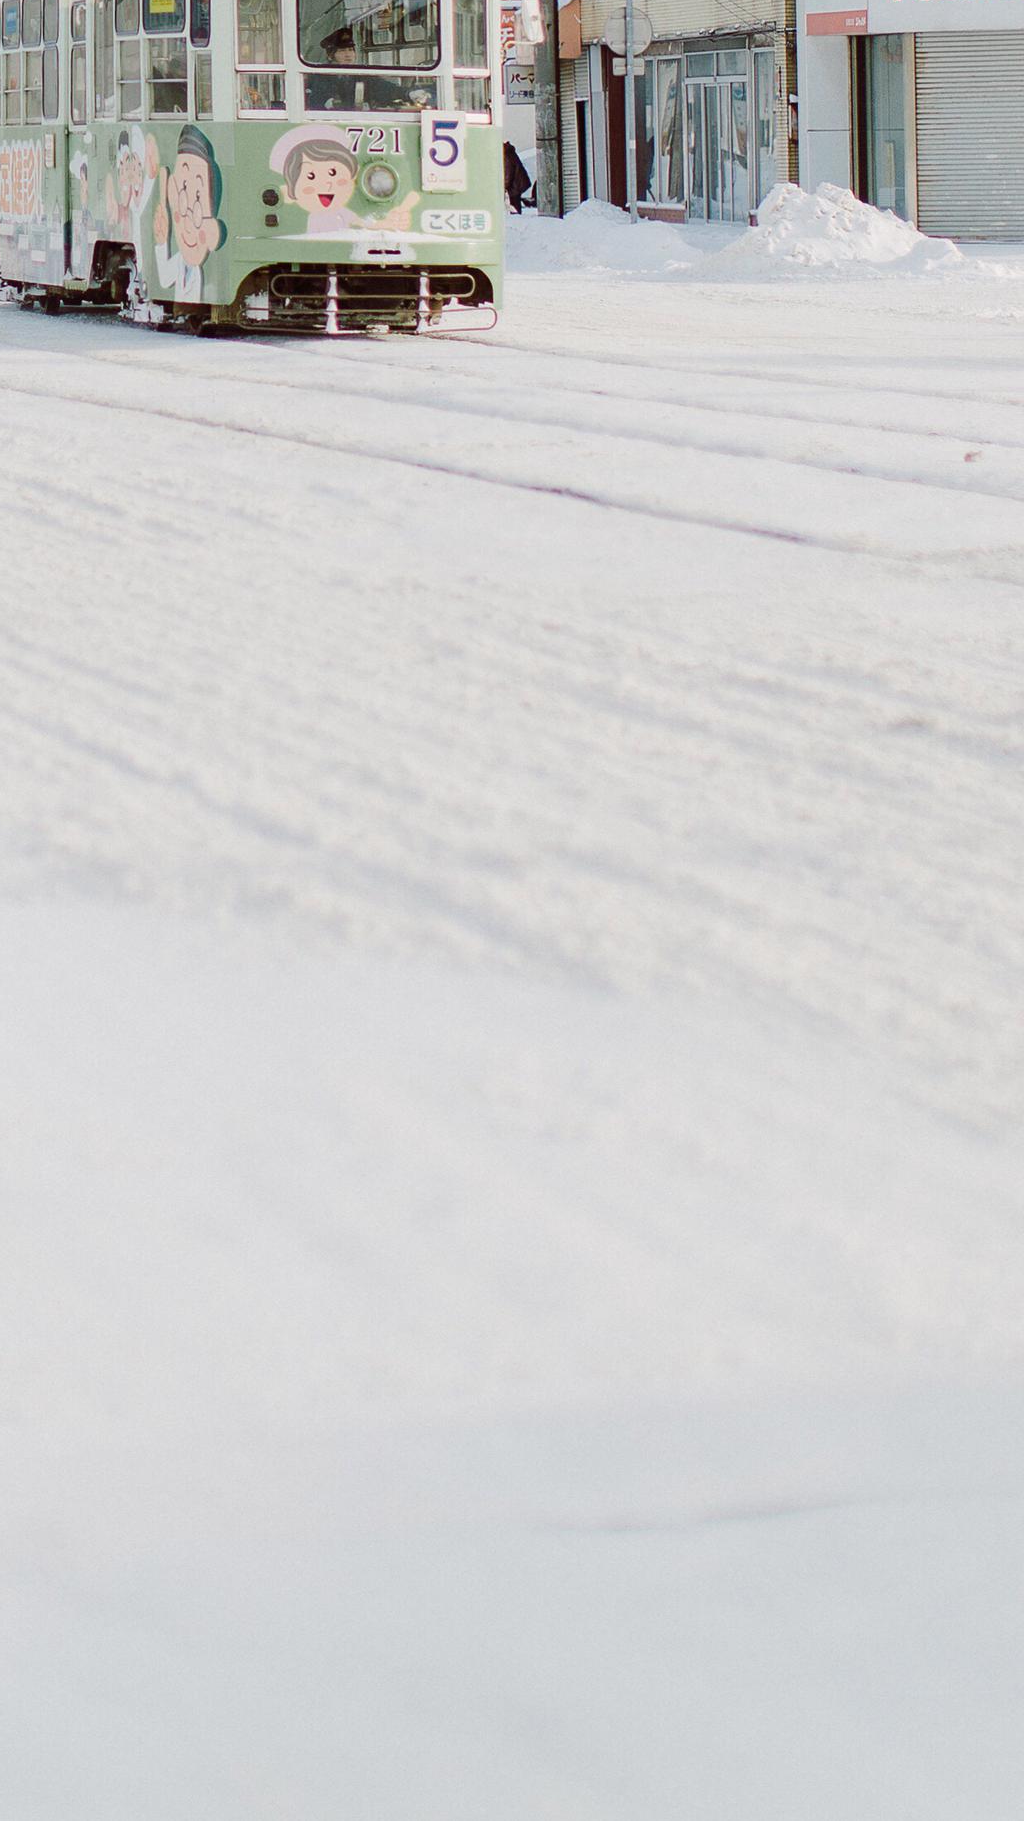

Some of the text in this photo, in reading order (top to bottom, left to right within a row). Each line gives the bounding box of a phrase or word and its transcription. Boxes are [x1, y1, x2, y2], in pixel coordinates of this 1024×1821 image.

[347, 127, 403, 154] 721
[429, 120, 459, 167] 5
[429, 213, 486, 231] こくほ号
